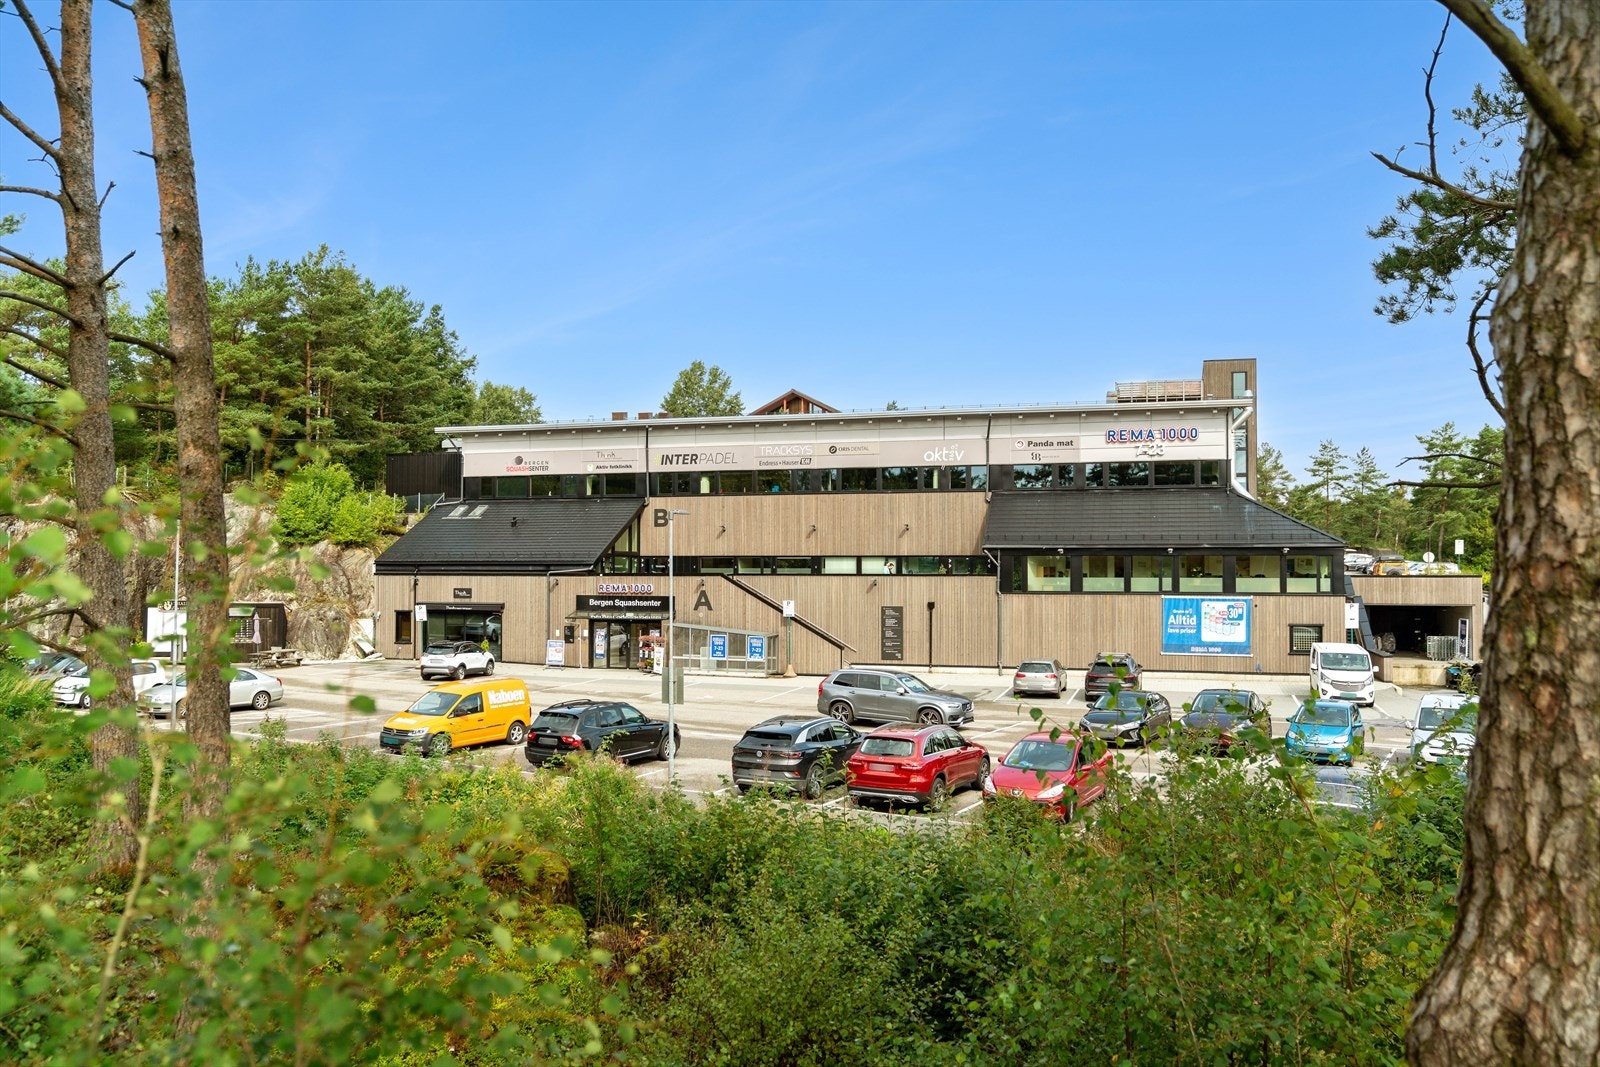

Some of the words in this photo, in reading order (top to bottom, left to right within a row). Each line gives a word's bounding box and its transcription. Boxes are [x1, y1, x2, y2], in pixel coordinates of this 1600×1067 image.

[1106, 428, 1156, 441] REMA
[1160, 427, 1199, 440] 1000
[759, 445, 813, 456] TRACKSYS
[1135, 443, 1166, 456] 7-23
[660, 452, 738, 466] INTERPADEL
[505, 465, 549, 473] SQUASHSENTER
[654, 508, 669, 527] B
[598, 584, 628, 593] REMA
[629, 584, 653, 593] 1000
[589, 599, 613, 607] Bergen
[614, 599, 661, 607] Squashsenter
[693, 589, 713, 611] A
[1168, 614, 1197, 625] Alltid
[487, 689, 525, 705] Naboen
